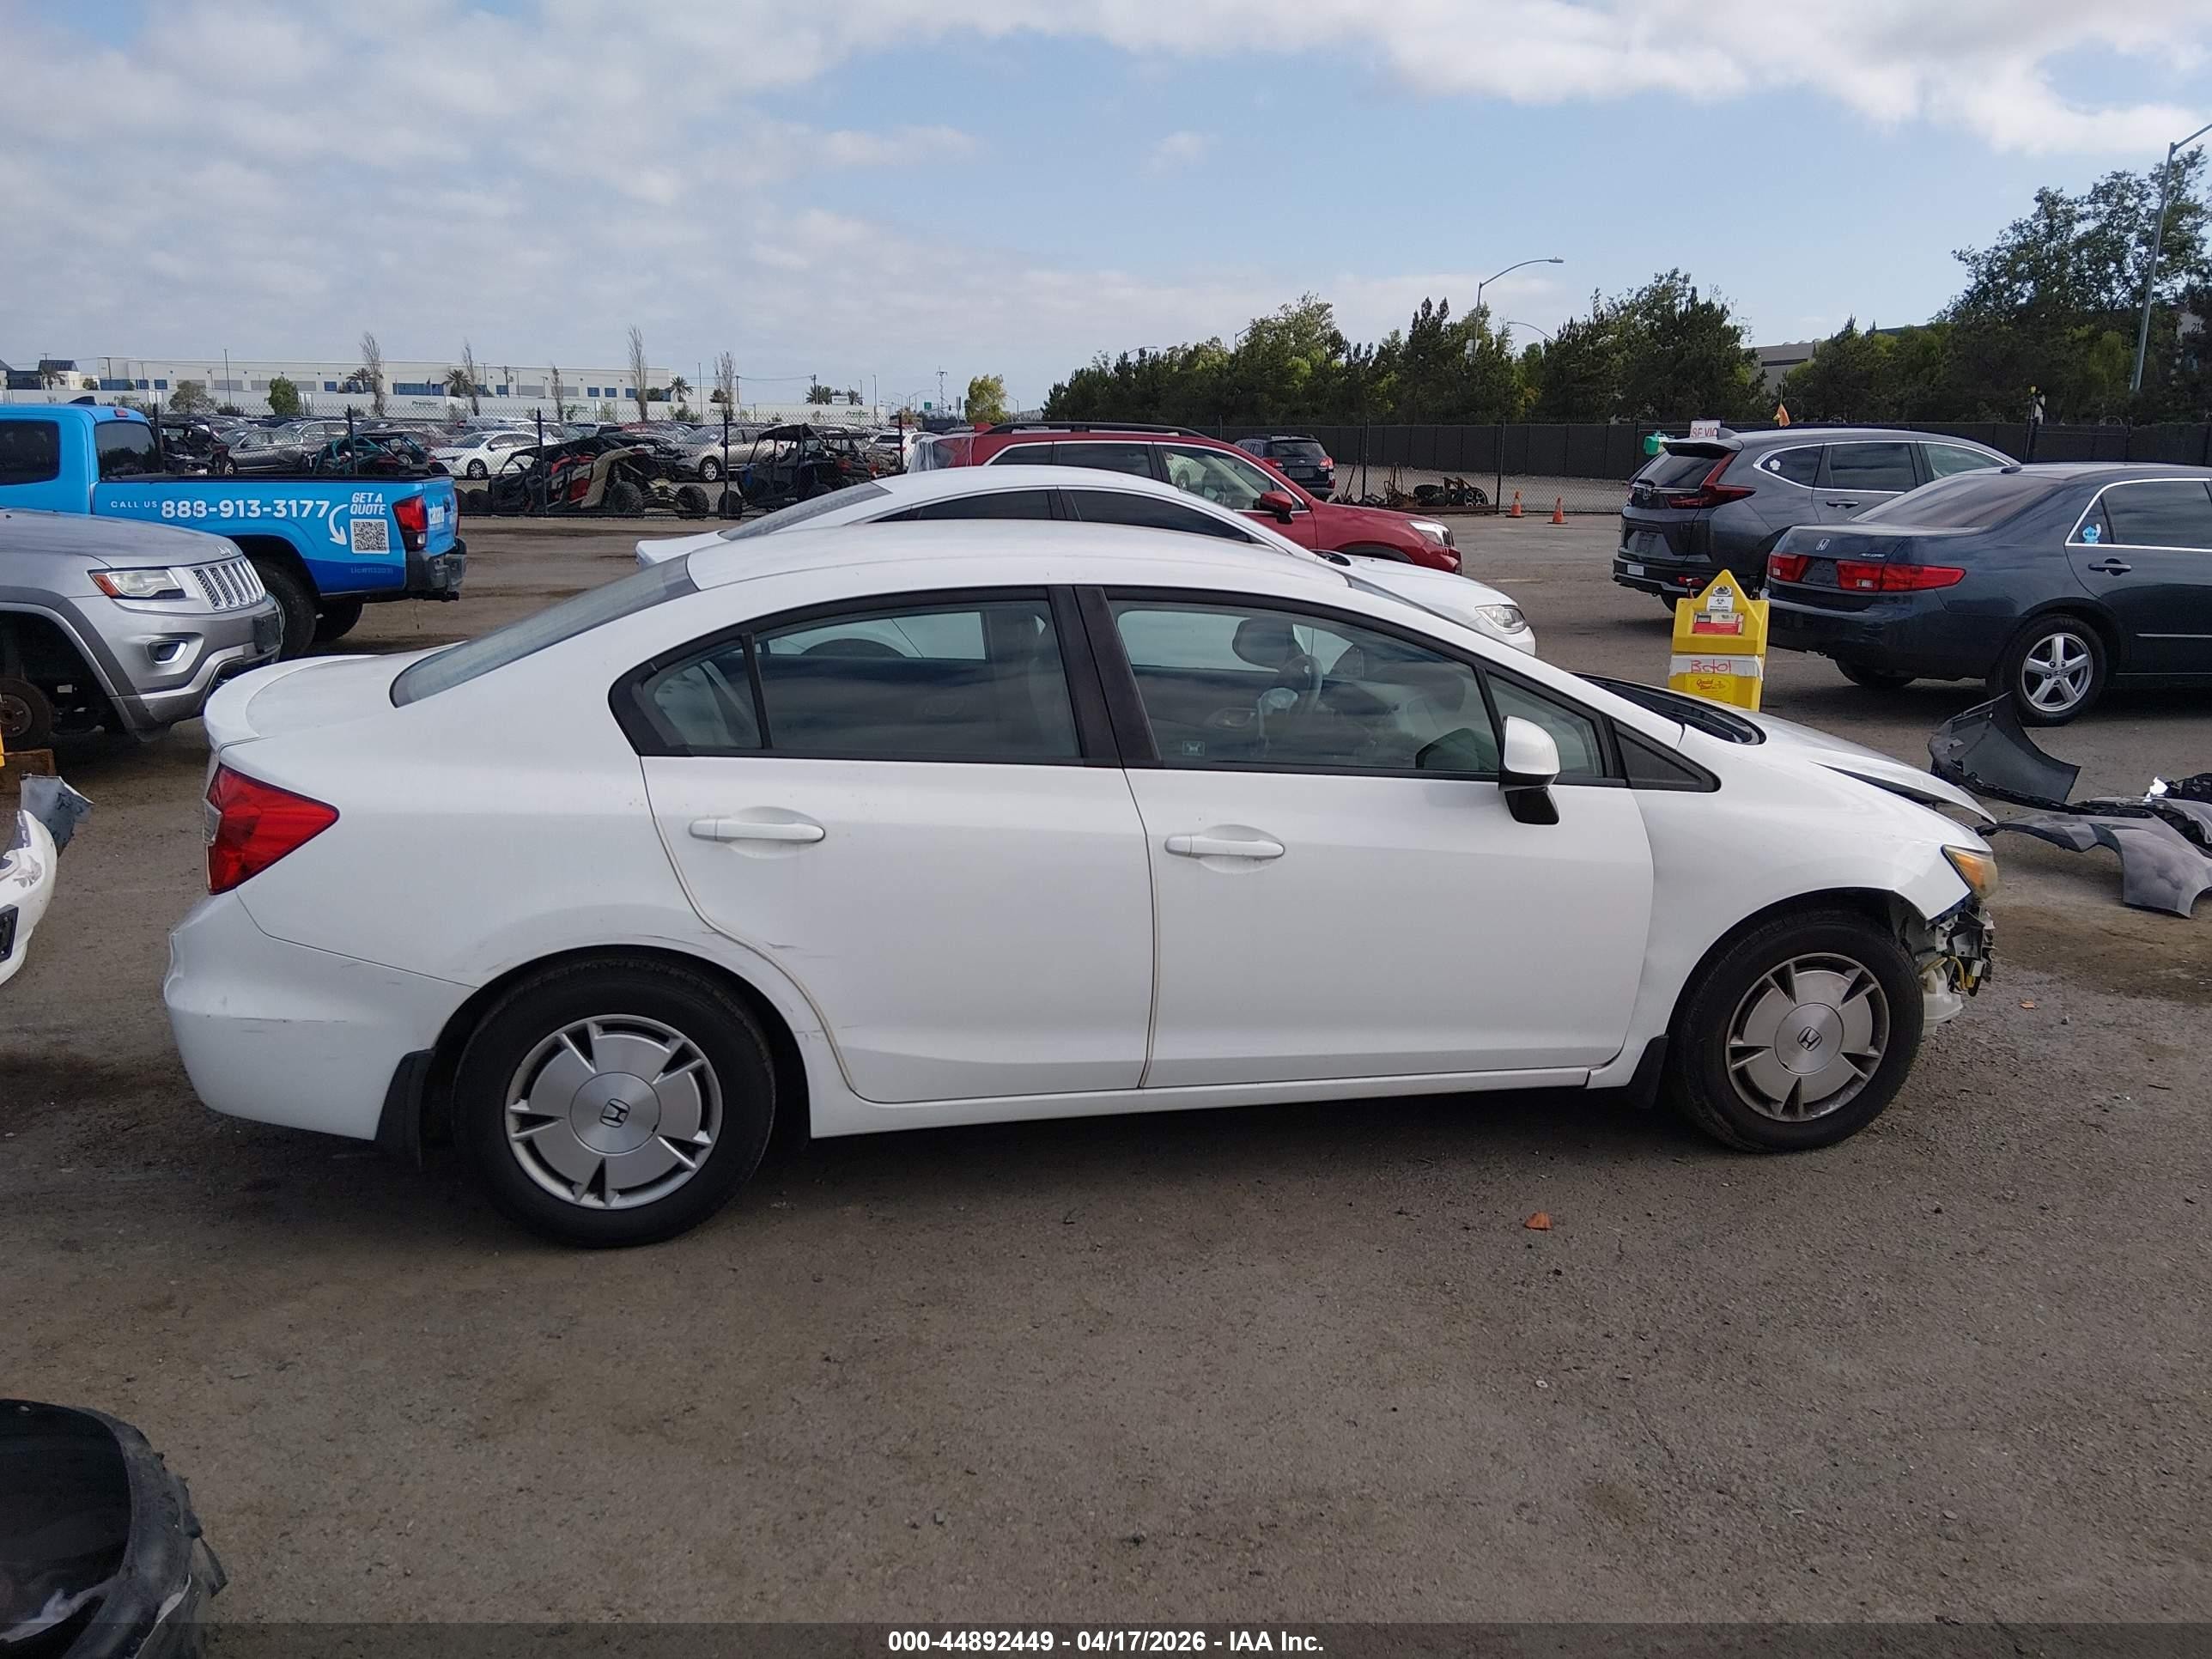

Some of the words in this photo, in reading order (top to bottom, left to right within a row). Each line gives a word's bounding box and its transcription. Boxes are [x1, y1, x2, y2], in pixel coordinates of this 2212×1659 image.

[352, 492, 374, 503] GET
[374, 492, 383, 503] A
[161, 500, 331, 518] 888-913-3177
[349, 503, 386, 515] QUOTE
